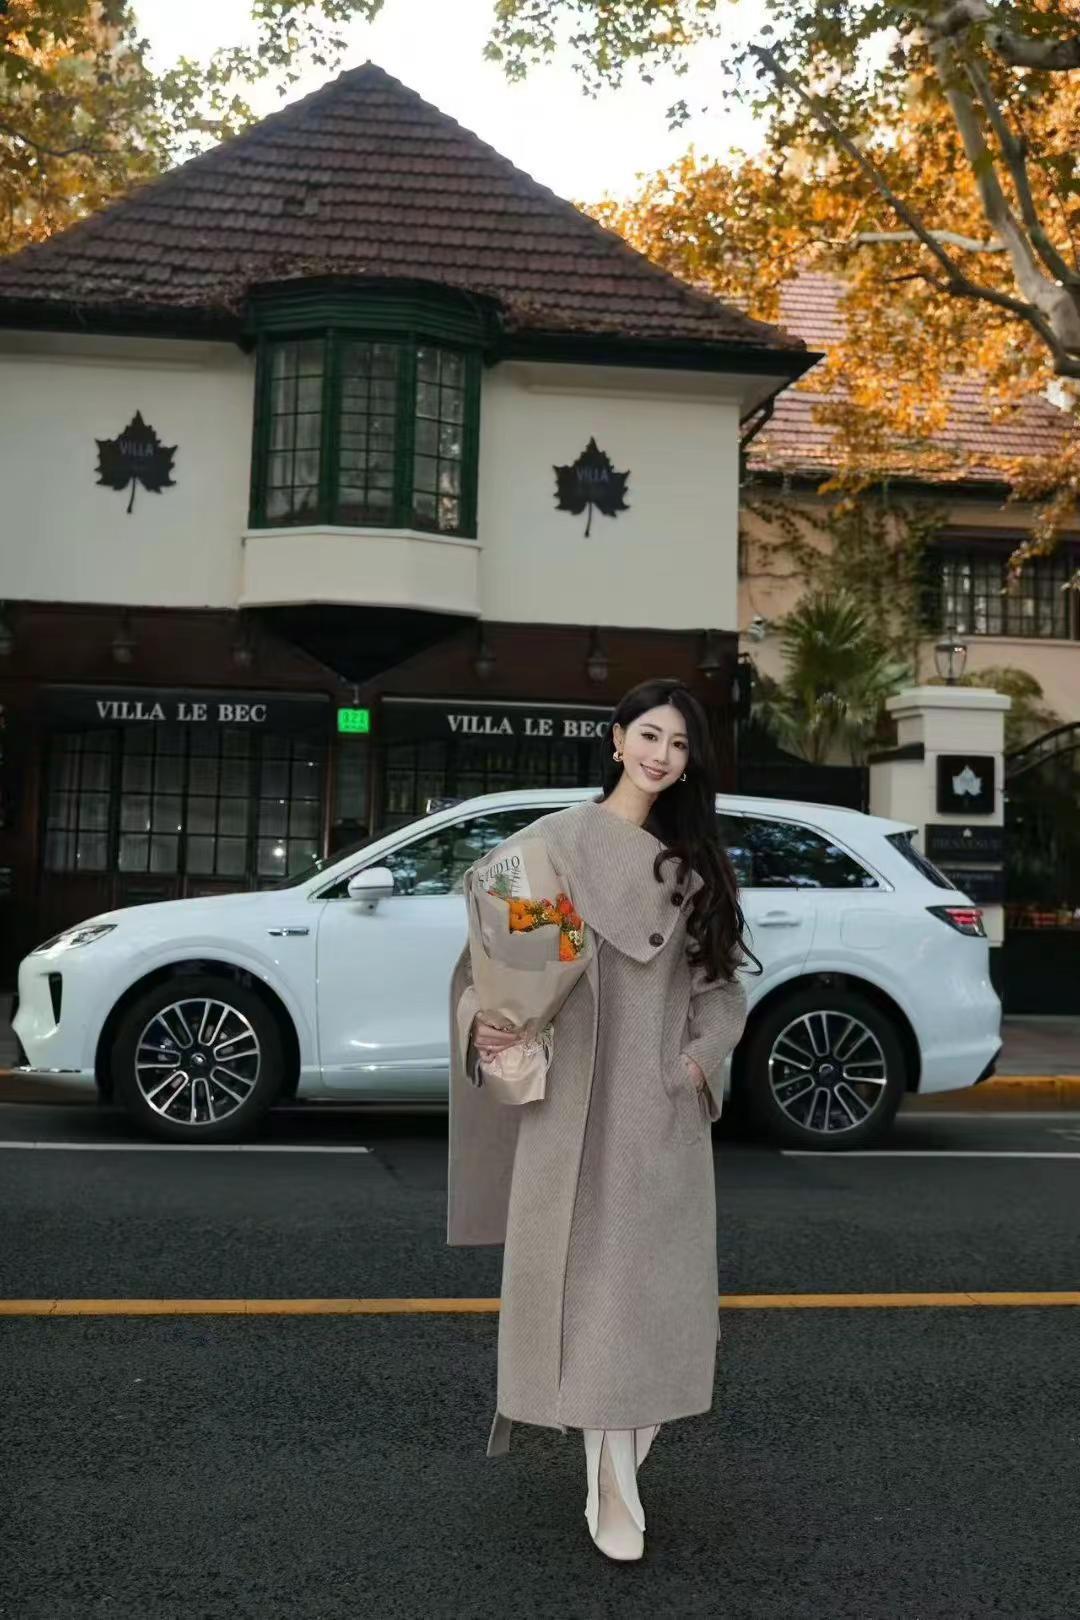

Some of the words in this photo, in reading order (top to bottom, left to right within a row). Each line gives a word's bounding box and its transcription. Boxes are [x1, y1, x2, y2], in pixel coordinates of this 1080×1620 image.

[120, 438, 154, 457] VILLA
[575, 464, 609, 482] VILLA
[96, 700, 166, 721] VILLA
[176, 703, 207, 722] LE
[217, 703, 267, 723] BEC
[447, 714, 514, 735] VILLA
[523, 718, 554, 737] LE
[562, 719, 611, 738] BEC
[478, 855, 521, 882] STUDIO
